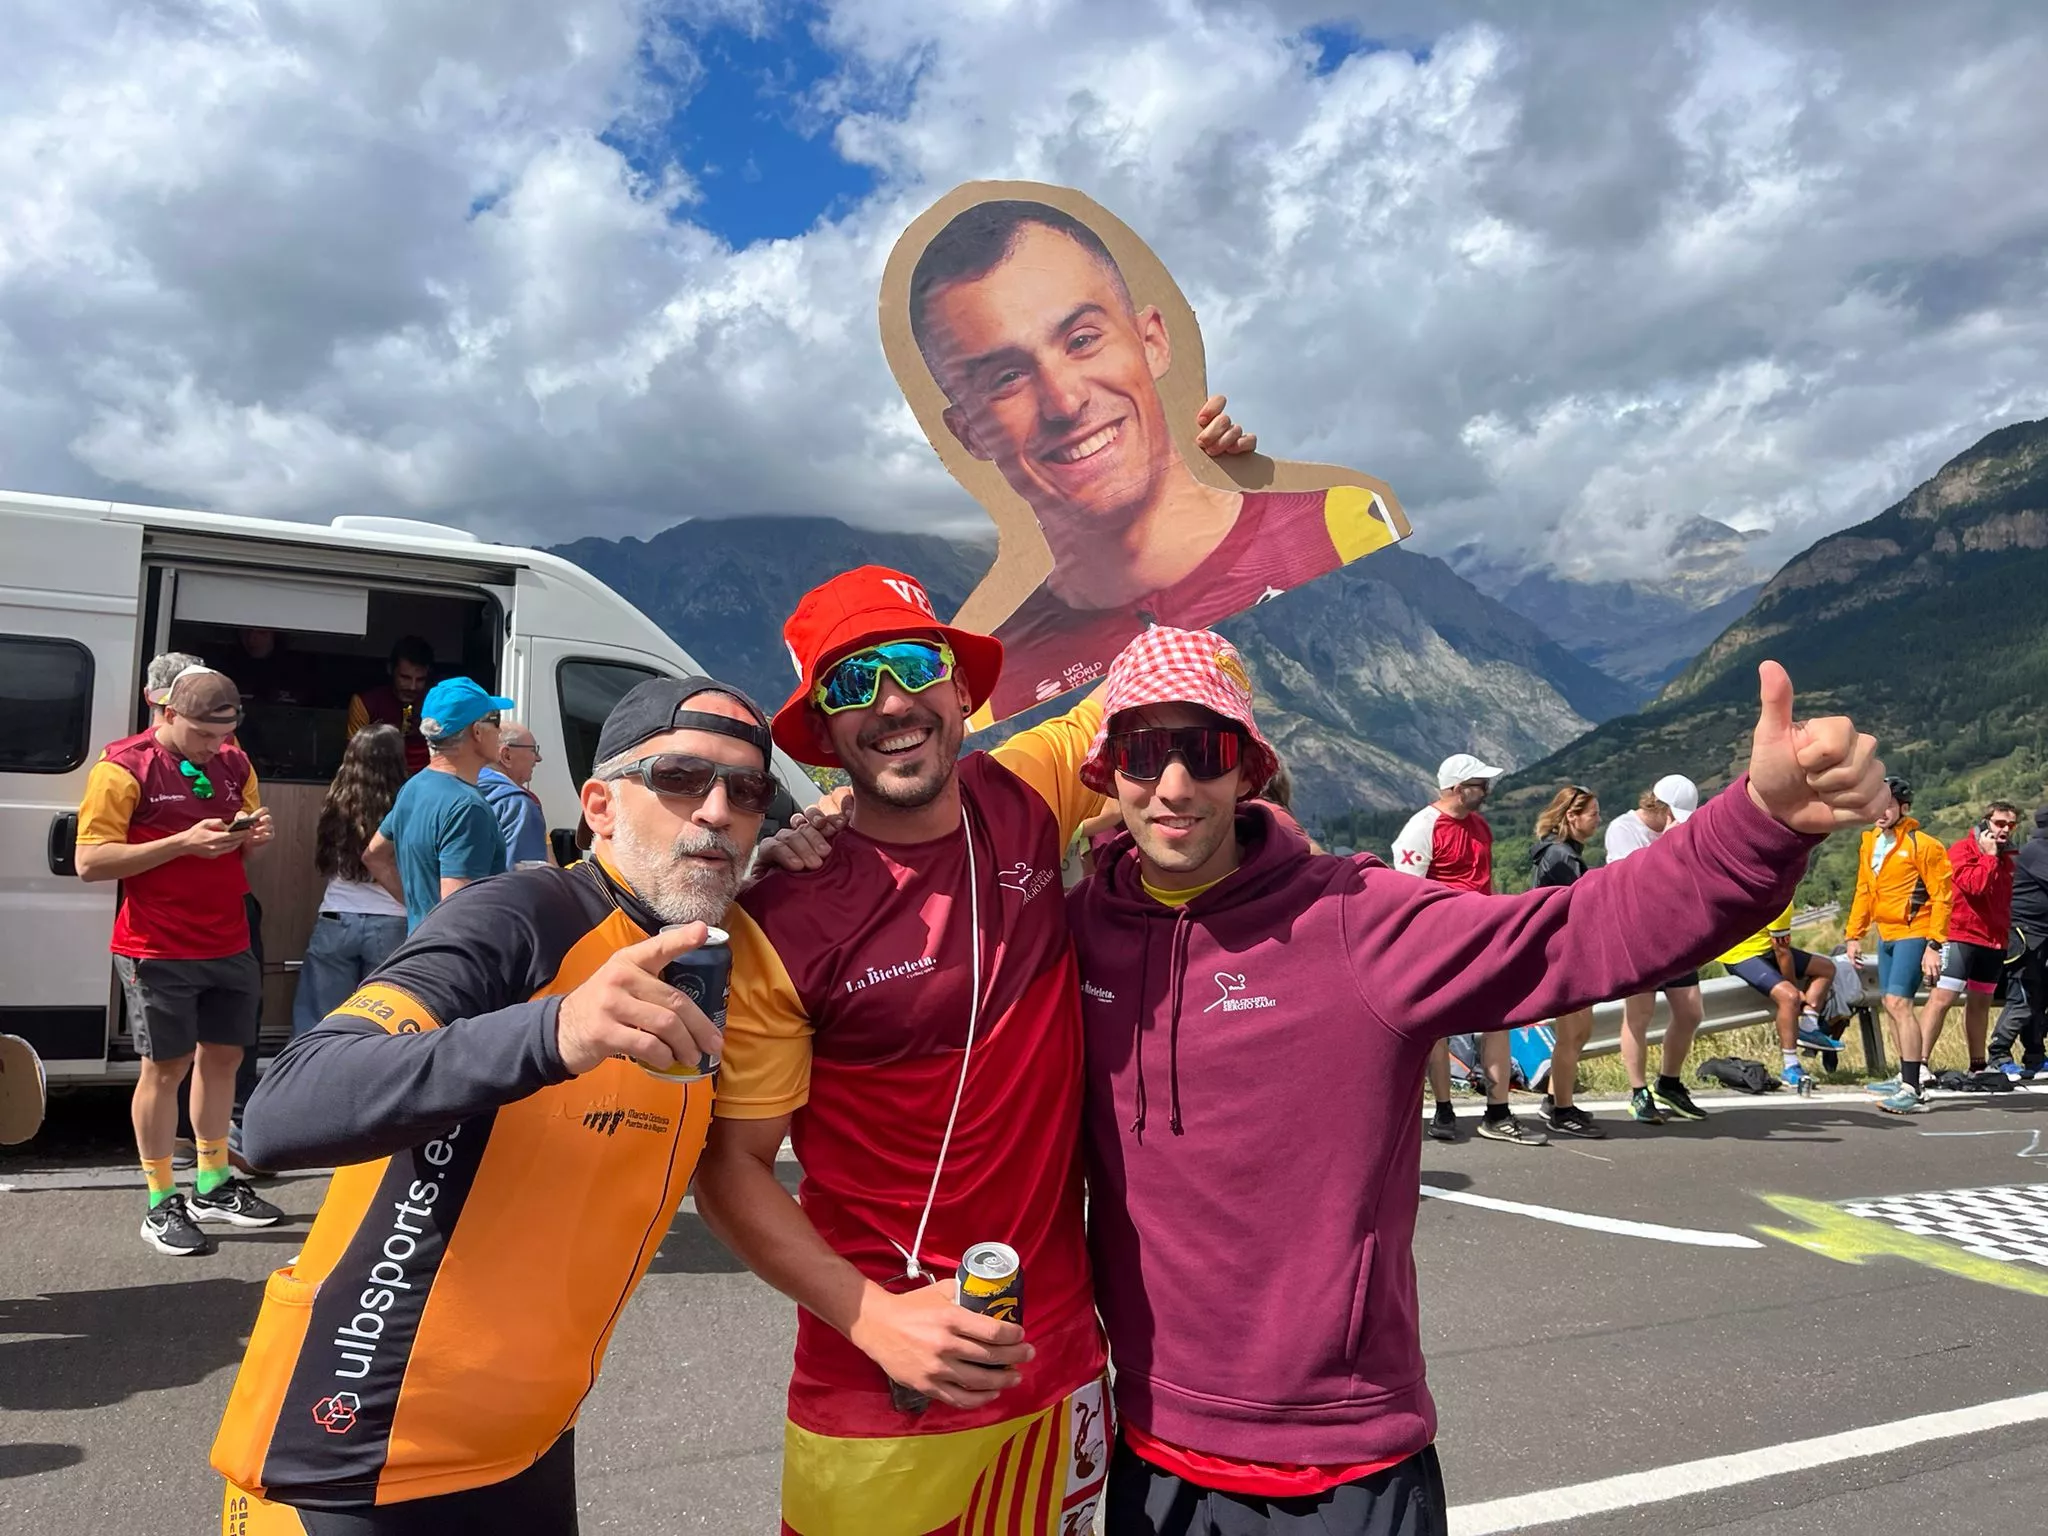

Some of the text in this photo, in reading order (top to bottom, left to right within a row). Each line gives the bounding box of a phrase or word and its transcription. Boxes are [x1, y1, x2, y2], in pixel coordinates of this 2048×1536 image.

[881, 579, 936, 620] VE
[1063, 662, 1084, 677] UCI
[1066, 661, 1103, 684] WORLD
[1070, 672, 1099, 689] TEAM
[845, 956, 937, 994] La Bicicleta.
[1254, 999, 1276, 1008] SAMI
